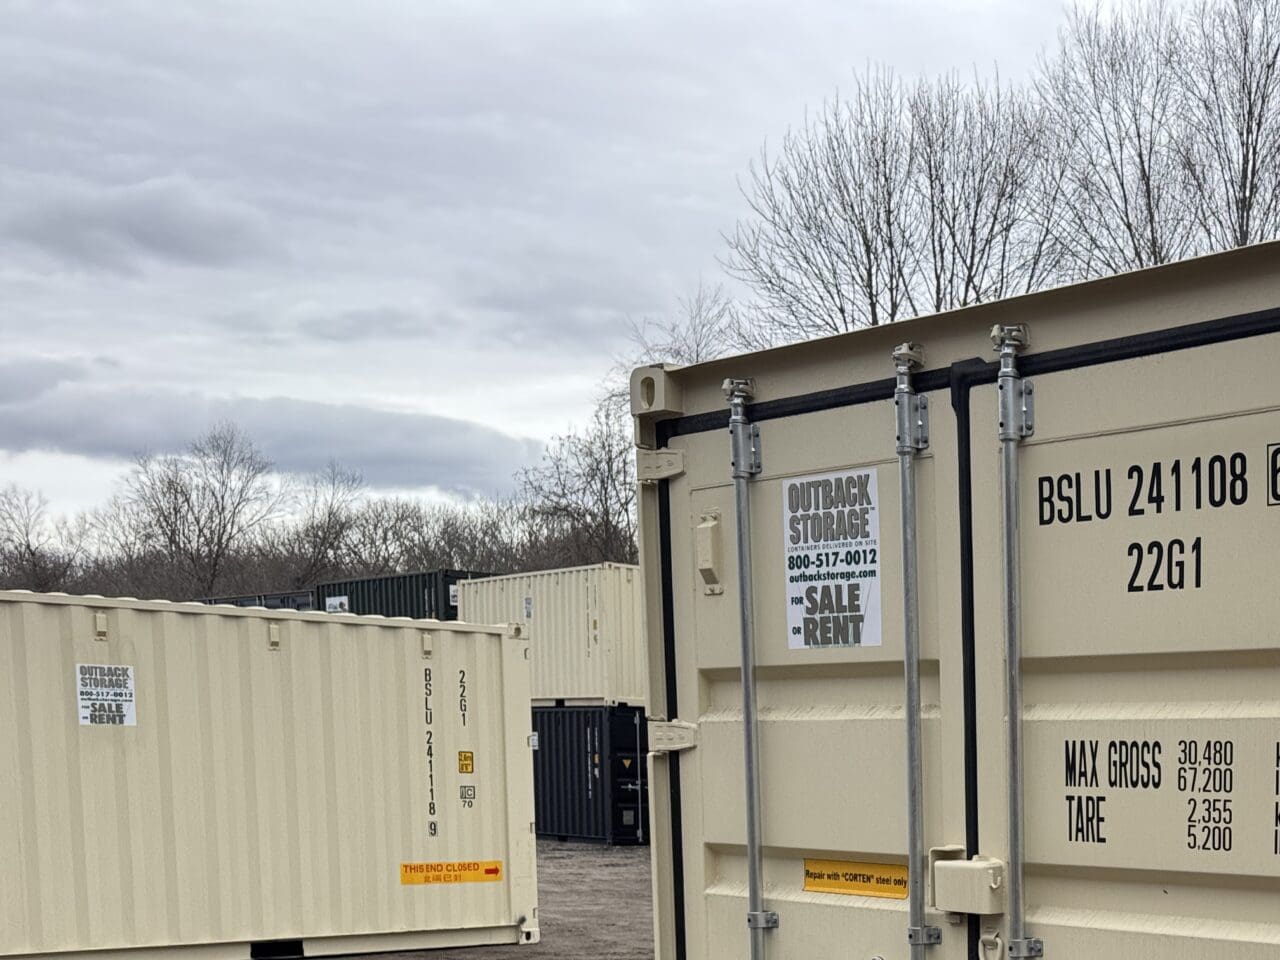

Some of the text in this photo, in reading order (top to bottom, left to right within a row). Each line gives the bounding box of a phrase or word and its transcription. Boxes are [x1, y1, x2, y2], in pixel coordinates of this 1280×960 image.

[788, 474, 872, 514] OUTBACK
[1038, 468, 1112, 526] BSLU
[1127, 452, 1248, 517] 241108
[789, 507, 870, 545] STORAGE
[788, 544, 820, 553] CONTAINERS
[822, 541, 853, 550] DELIVERED
[788, 549, 877, 570] 800-517-0012
[789, 569, 877, 584] outbackstorage.com
[1127, 537, 1202, 593] 22G1
[791, 583, 861, 615] FOR SALE
[792, 614, 865, 646] OR RENT
[80, 666, 129, 678] OUTBACK
[81, 677, 128, 689] STORAGE
[90, 703, 124, 714] SALE
[459, 669, 467, 727] 22G1
[90, 714, 126, 724] RENT
[424, 668, 437, 836] BSLU 241118 9
[1065, 740, 1099, 788] MAX
[1108, 740, 1162, 789] GROSS
[1177, 740, 1234, 767] 30,480
[1177, 767, 1233, 793] 67,200
[1065, 795, 1107, 843] TARE
[1187, 798, 1232, 825] 2,355
[1187, 825, 1232, 851] 5,200
[403, 863, 479, 873] THIS END CLOSED
[805, 869, 825, 881] Repair
[826, 872, 840, 880] with
[876, 875, 892, 885] steel
[894, 877, 907, 888] only
